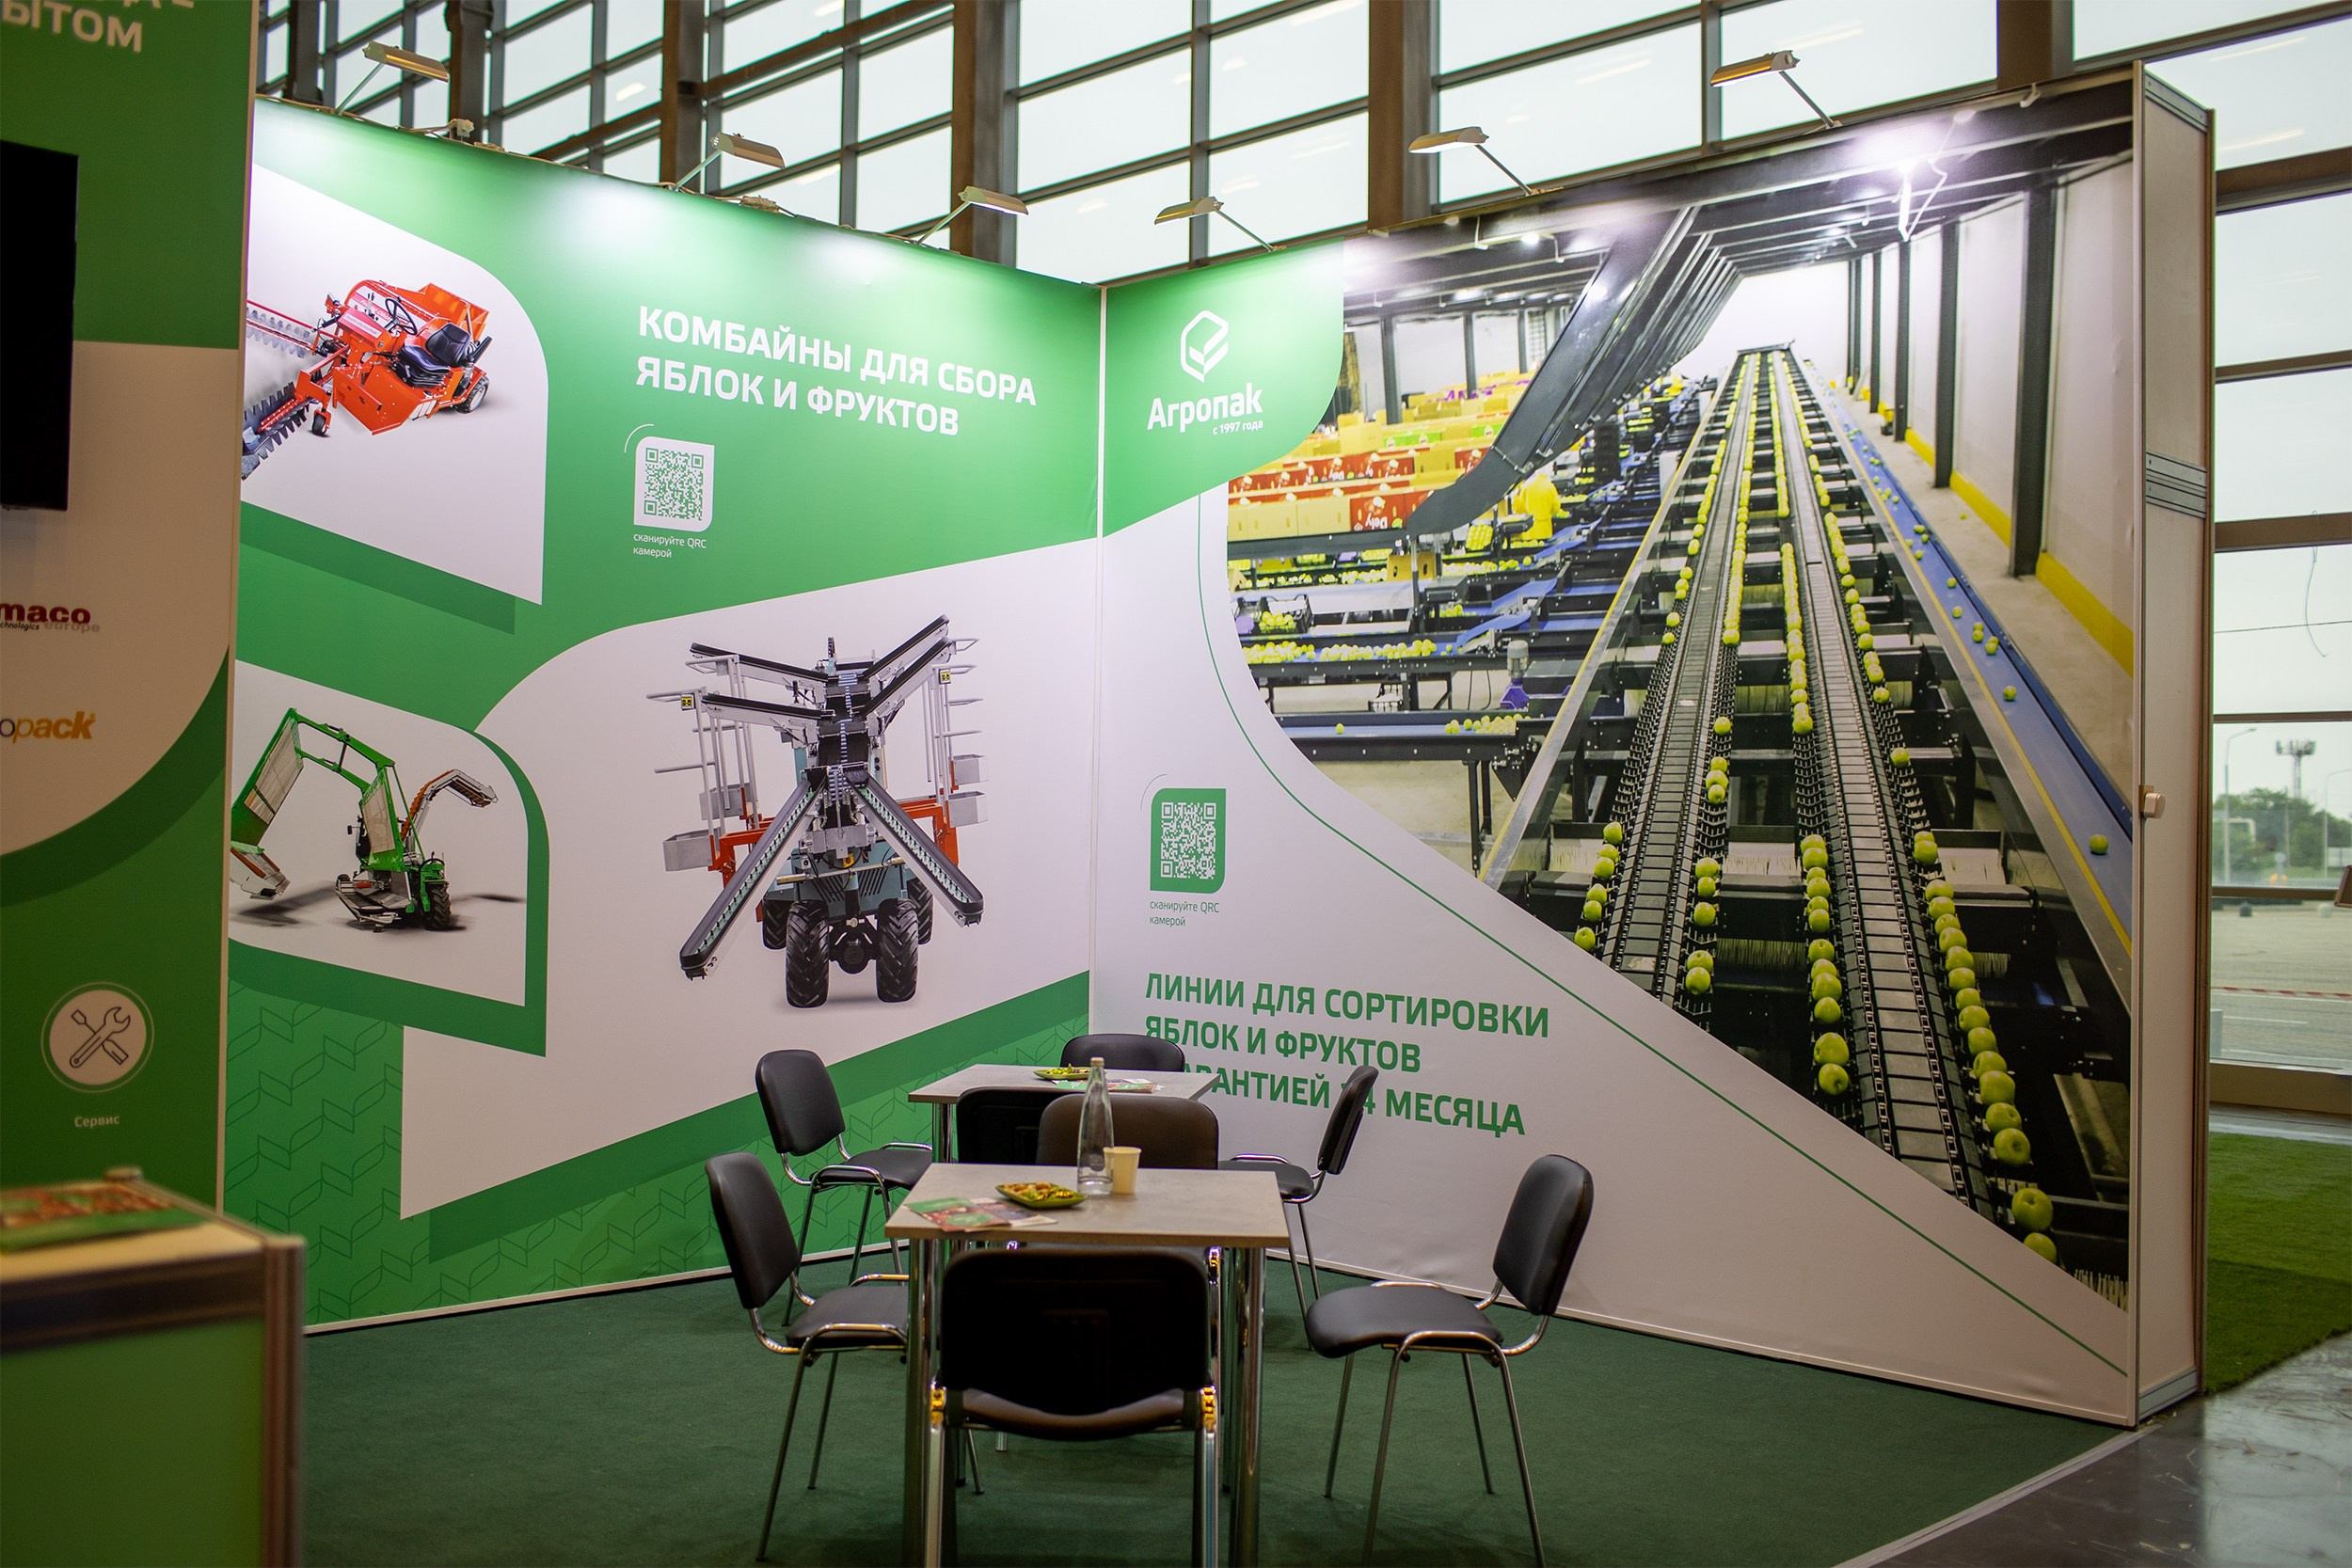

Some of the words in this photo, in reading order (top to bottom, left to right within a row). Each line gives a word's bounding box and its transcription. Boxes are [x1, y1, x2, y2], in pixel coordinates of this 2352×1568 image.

[639, 306, 850, 372] КОМБАЙНЫ
[860, 348, 929, 387] ДЛЯ
[938, 361, 1037, 405] СБОРА
[635, 356, 764, 405] ЯБЛОК
[773, 378, 797, 410] И
[807, 386, 960, 436] ФРУКТОВ
[1213, 426, 1217, 435] с
[1219, 421, 1240, 434] 1997
[1242, 420, 1263, 432] года
[633, 533, 685, 546] сканируйте
[687, 537, 707, 549] QRC
[633, 547, 672, 559] камерой
[44, 622, 101, 633] europe
[0, 711, 95, 743] opack
[1150, 901, 1198, 912] сканируйте
[1200, 901, 1220, 914] QRC
[1150, 916, 1185, 927] камерой
[1146, 973, 1245, 1008] ЛИНИИ
[1252, 983, 1315, 1016] ДЛЯ
[1324, 988, 1549, 1038] СОРТИРОВКИ
[1146, 1016, 1239, 1052] ЯБЛОК
[1248, 1026, 1266, 1054] И
[1275, 1031, 1422, 1073] ФРУКТОВ
[1386, 1088, 1526, 1139] МЕСЯЦА
[74, 1116, 119, 1128] Сервис
